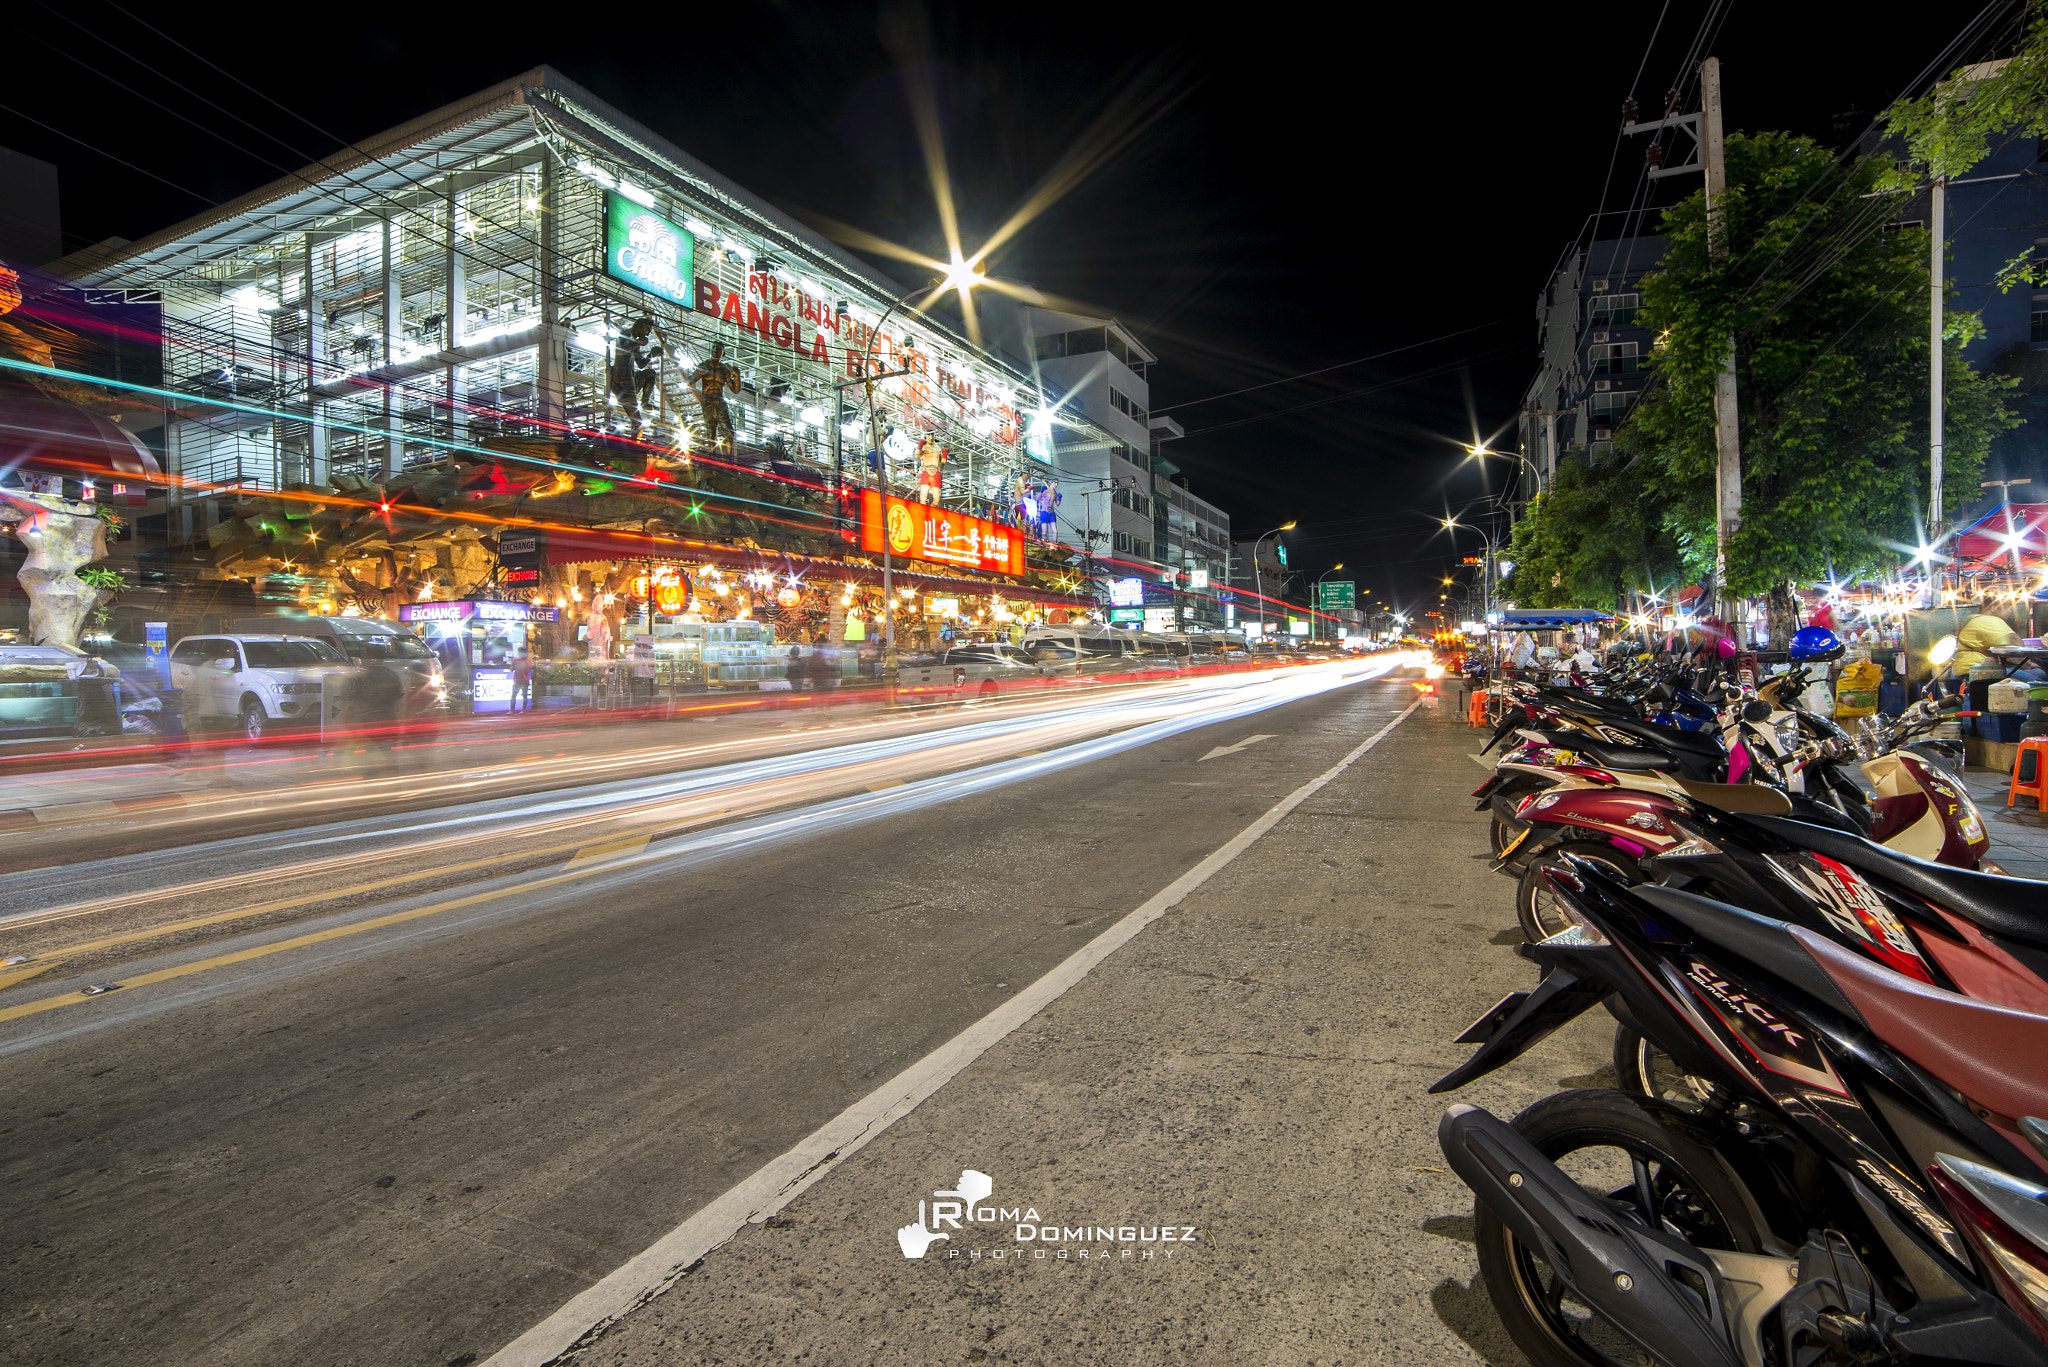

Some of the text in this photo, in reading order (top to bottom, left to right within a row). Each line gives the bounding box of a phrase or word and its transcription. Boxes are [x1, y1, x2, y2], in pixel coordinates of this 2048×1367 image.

[617, 246, 687, 300] Chang
[695, 276, 831, 367] BANGLA
[936, 367, 971, 400] THAI
[503, 541, 535, 552] EXCHANGE
[508, 570, 538, 582] EXCHANGE
[410, 606, 461, 621] EXCHANGE
[480, 608, 554, 621] EXCHANGE
[1686, 971, 1744, 1014] HELMET-IN
[1855, 1158, 1956, 1235] PGM-FI
